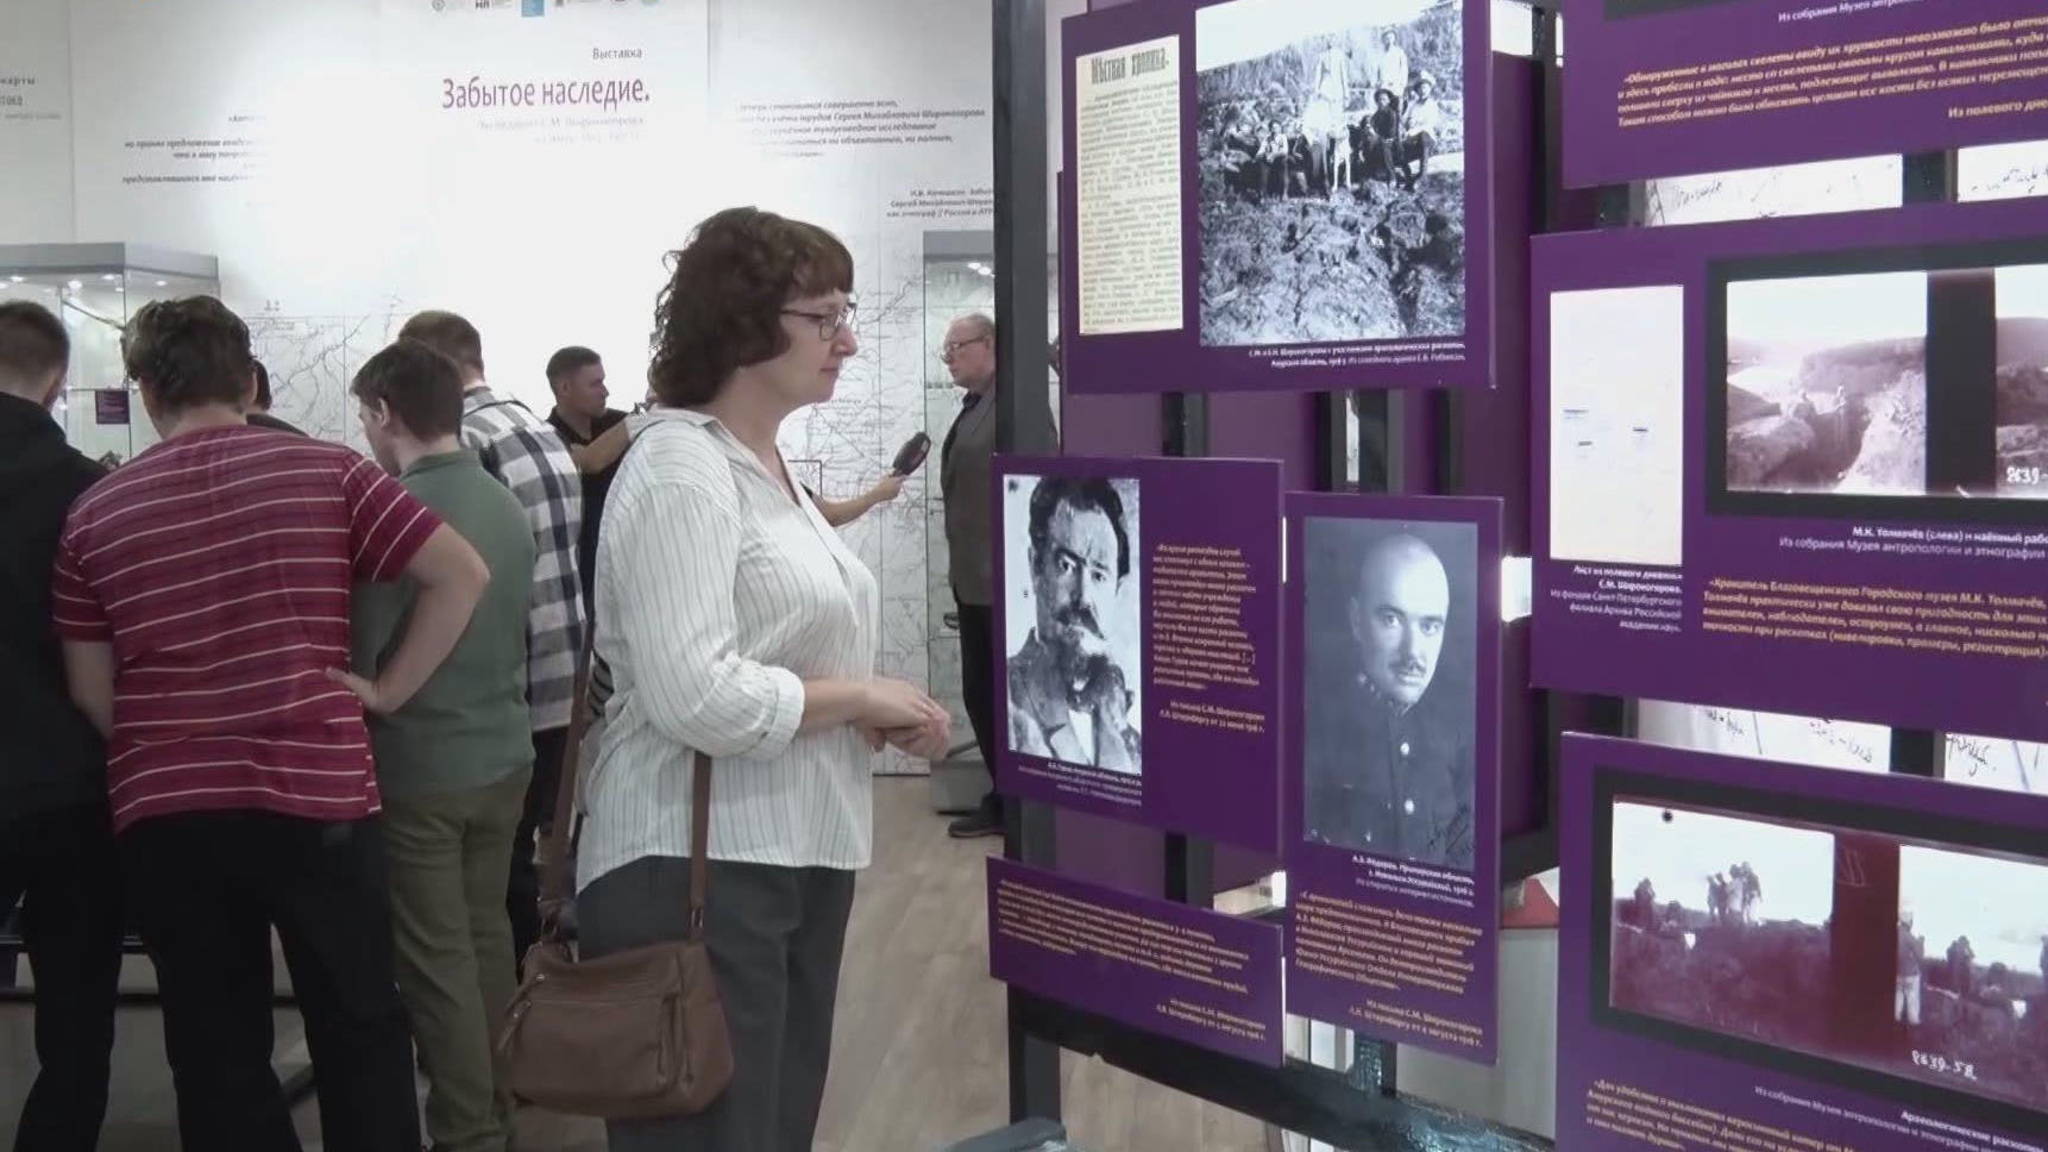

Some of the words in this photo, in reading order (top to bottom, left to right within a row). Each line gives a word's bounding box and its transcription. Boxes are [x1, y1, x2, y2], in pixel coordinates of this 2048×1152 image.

[592, 47, 642, 60] Выставка
[442, 76, 535, 109] Забытое
[542, 77, 650, 112] наследие.
[1794, 538, 1844, 550] собрания
[1846, 540, 1879, 552] Музея
[1881, 543, 1962, 554] антропологии
